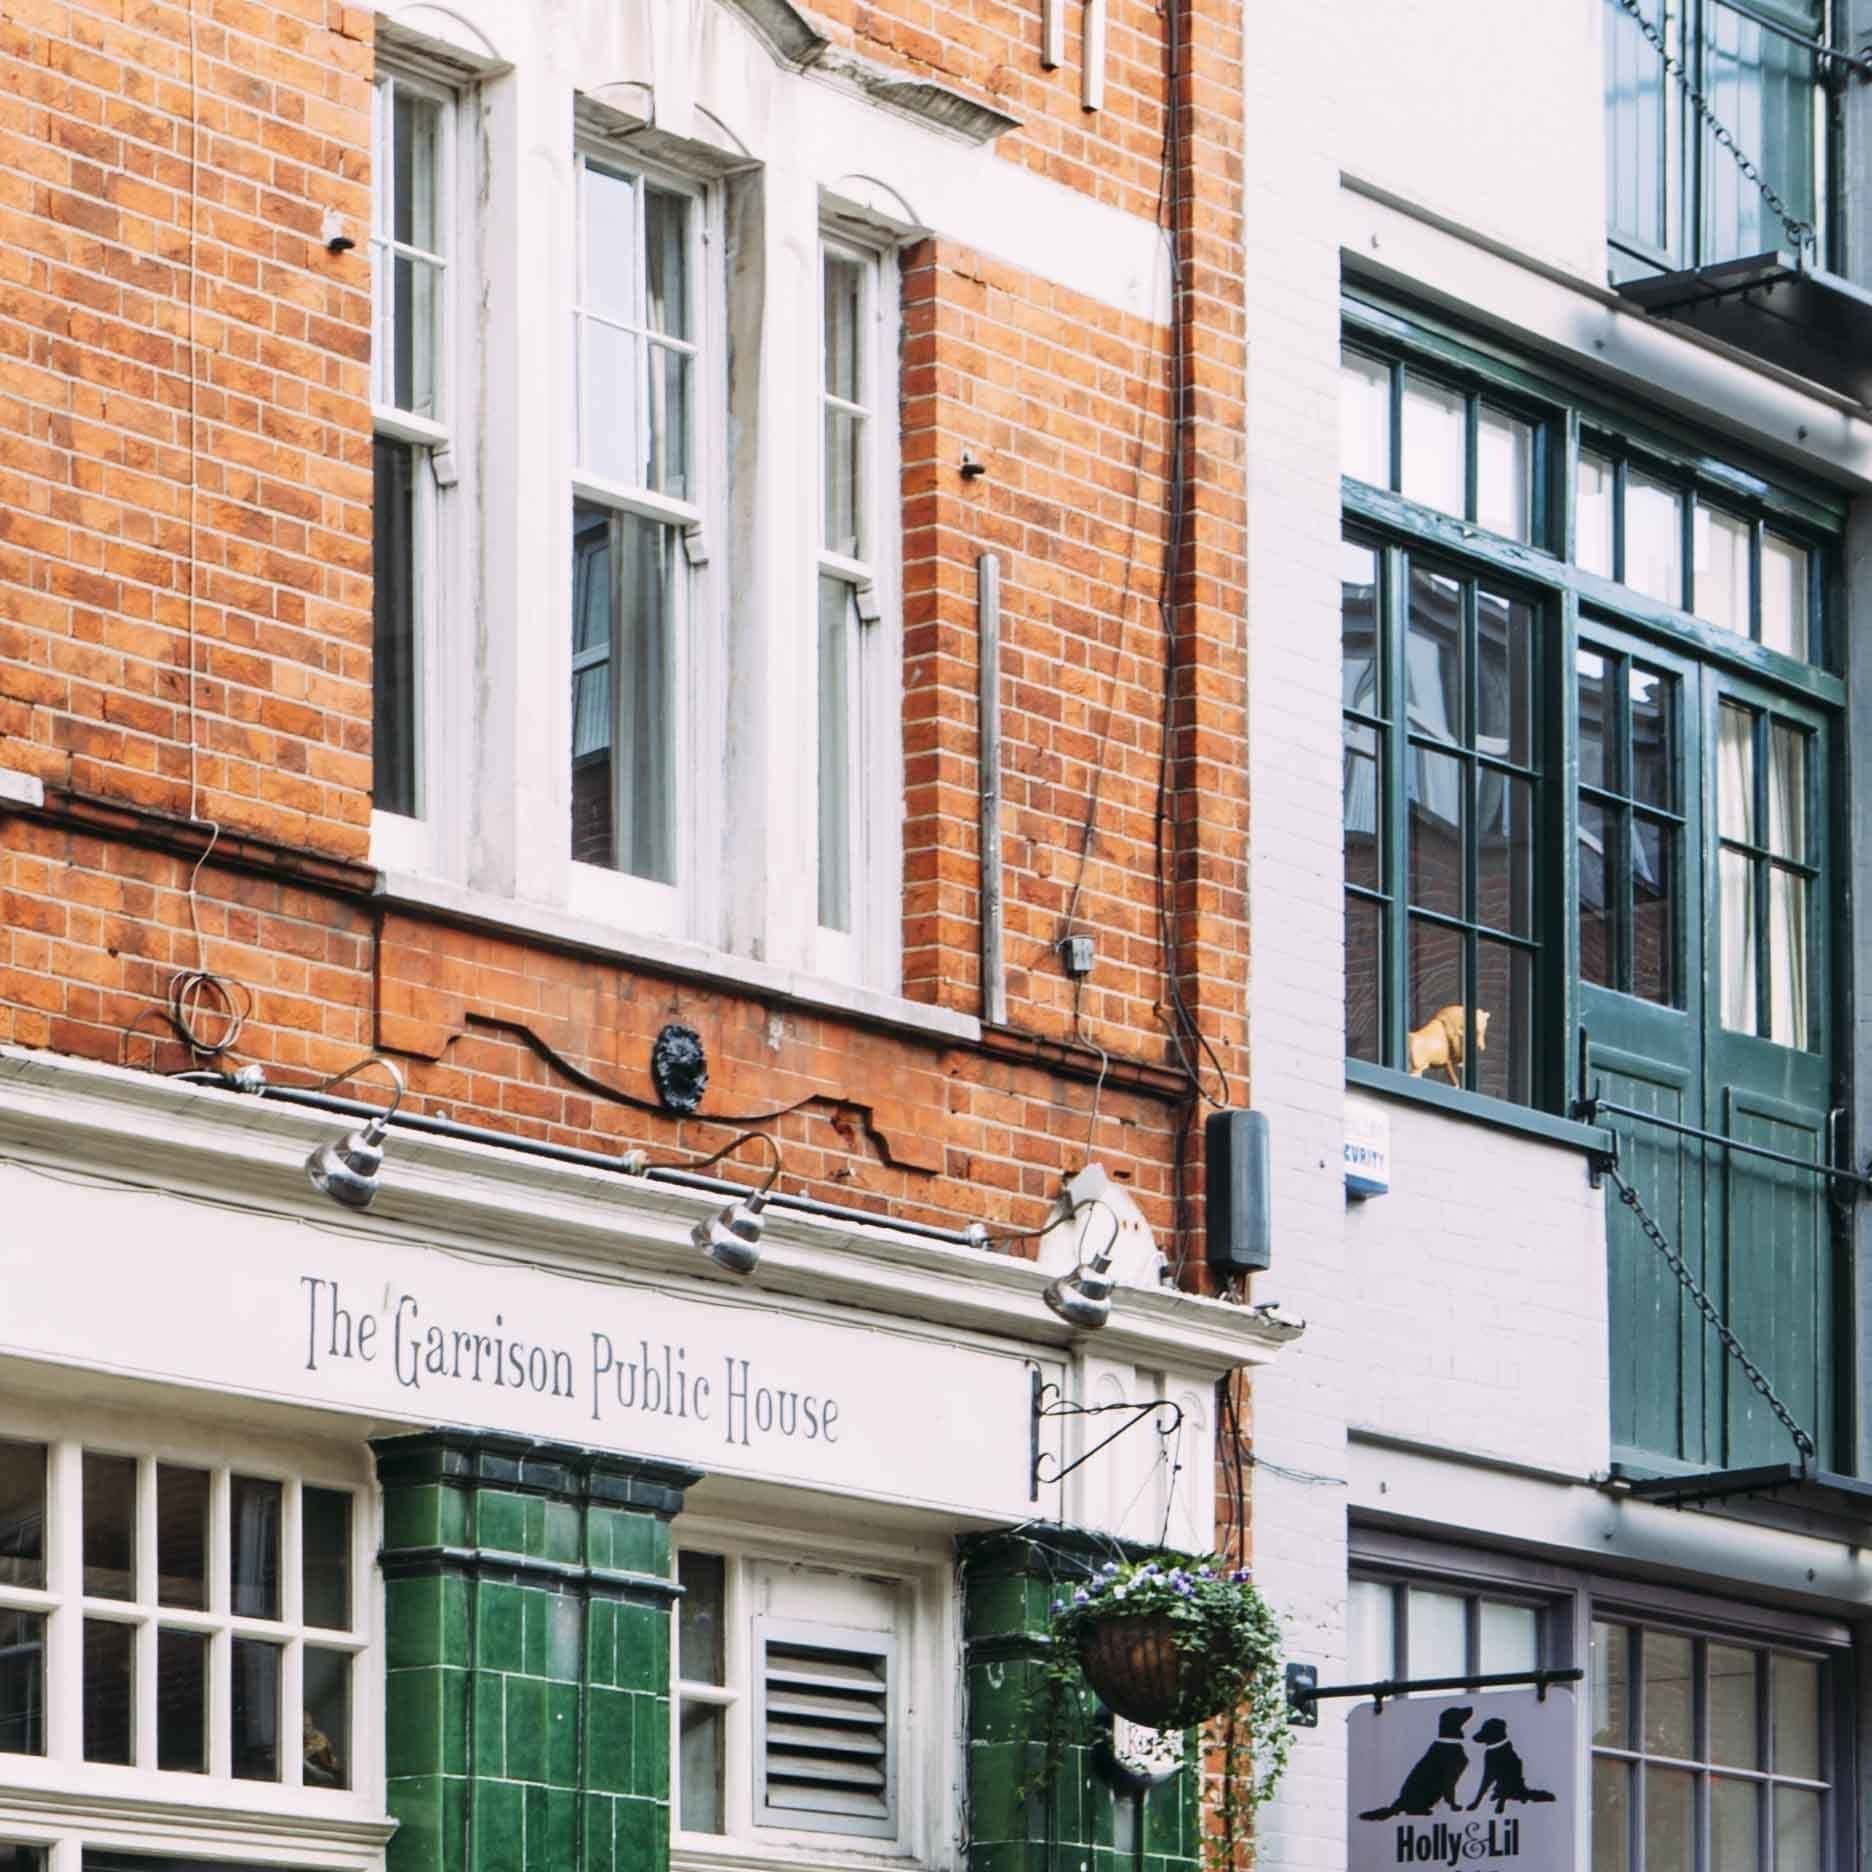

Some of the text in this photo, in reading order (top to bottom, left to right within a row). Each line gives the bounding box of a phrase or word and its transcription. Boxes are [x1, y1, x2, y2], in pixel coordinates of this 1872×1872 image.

[300, 1275, 840, 1447] The Garrison Public House
